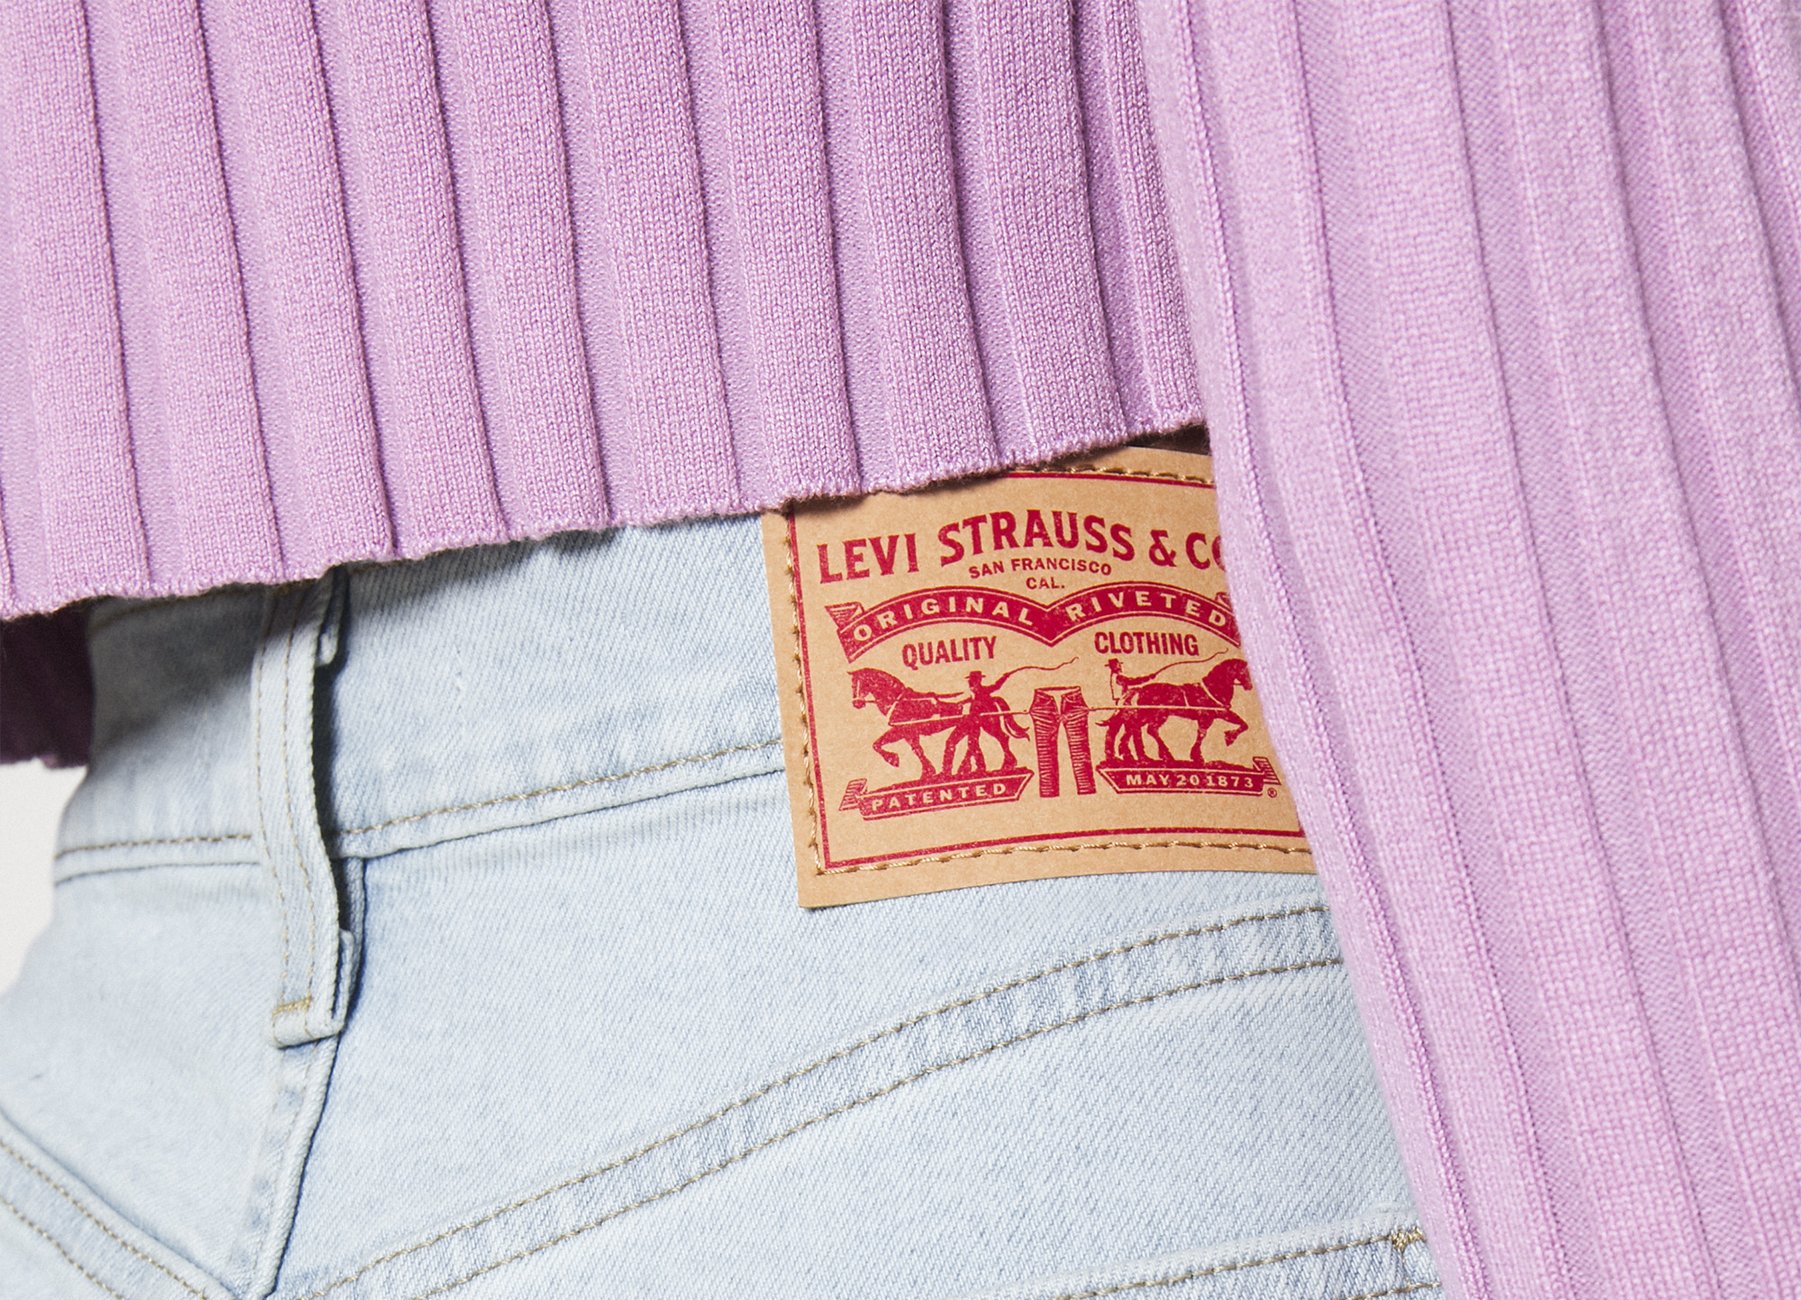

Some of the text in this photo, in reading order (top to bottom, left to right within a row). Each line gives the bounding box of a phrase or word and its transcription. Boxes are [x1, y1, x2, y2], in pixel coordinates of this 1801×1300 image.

[816, 533, 919, 584] LEVI
[937, 509, 1135, 567] STRAUSS
[1148, 529, 1177, 567] &
[968, 558, 1112, 579] SAN FRANCISCO
[1025, 577, 1065, 590] CAL.
[853, 591, 1226, 641] ORIGINAL RIVETED
[902, 631, 1199, 671] QUALITY CLOTHING
[1126, 774, 1254, 788] MAY 20 1873
[872, 783, 1006, 810] PATENTED
